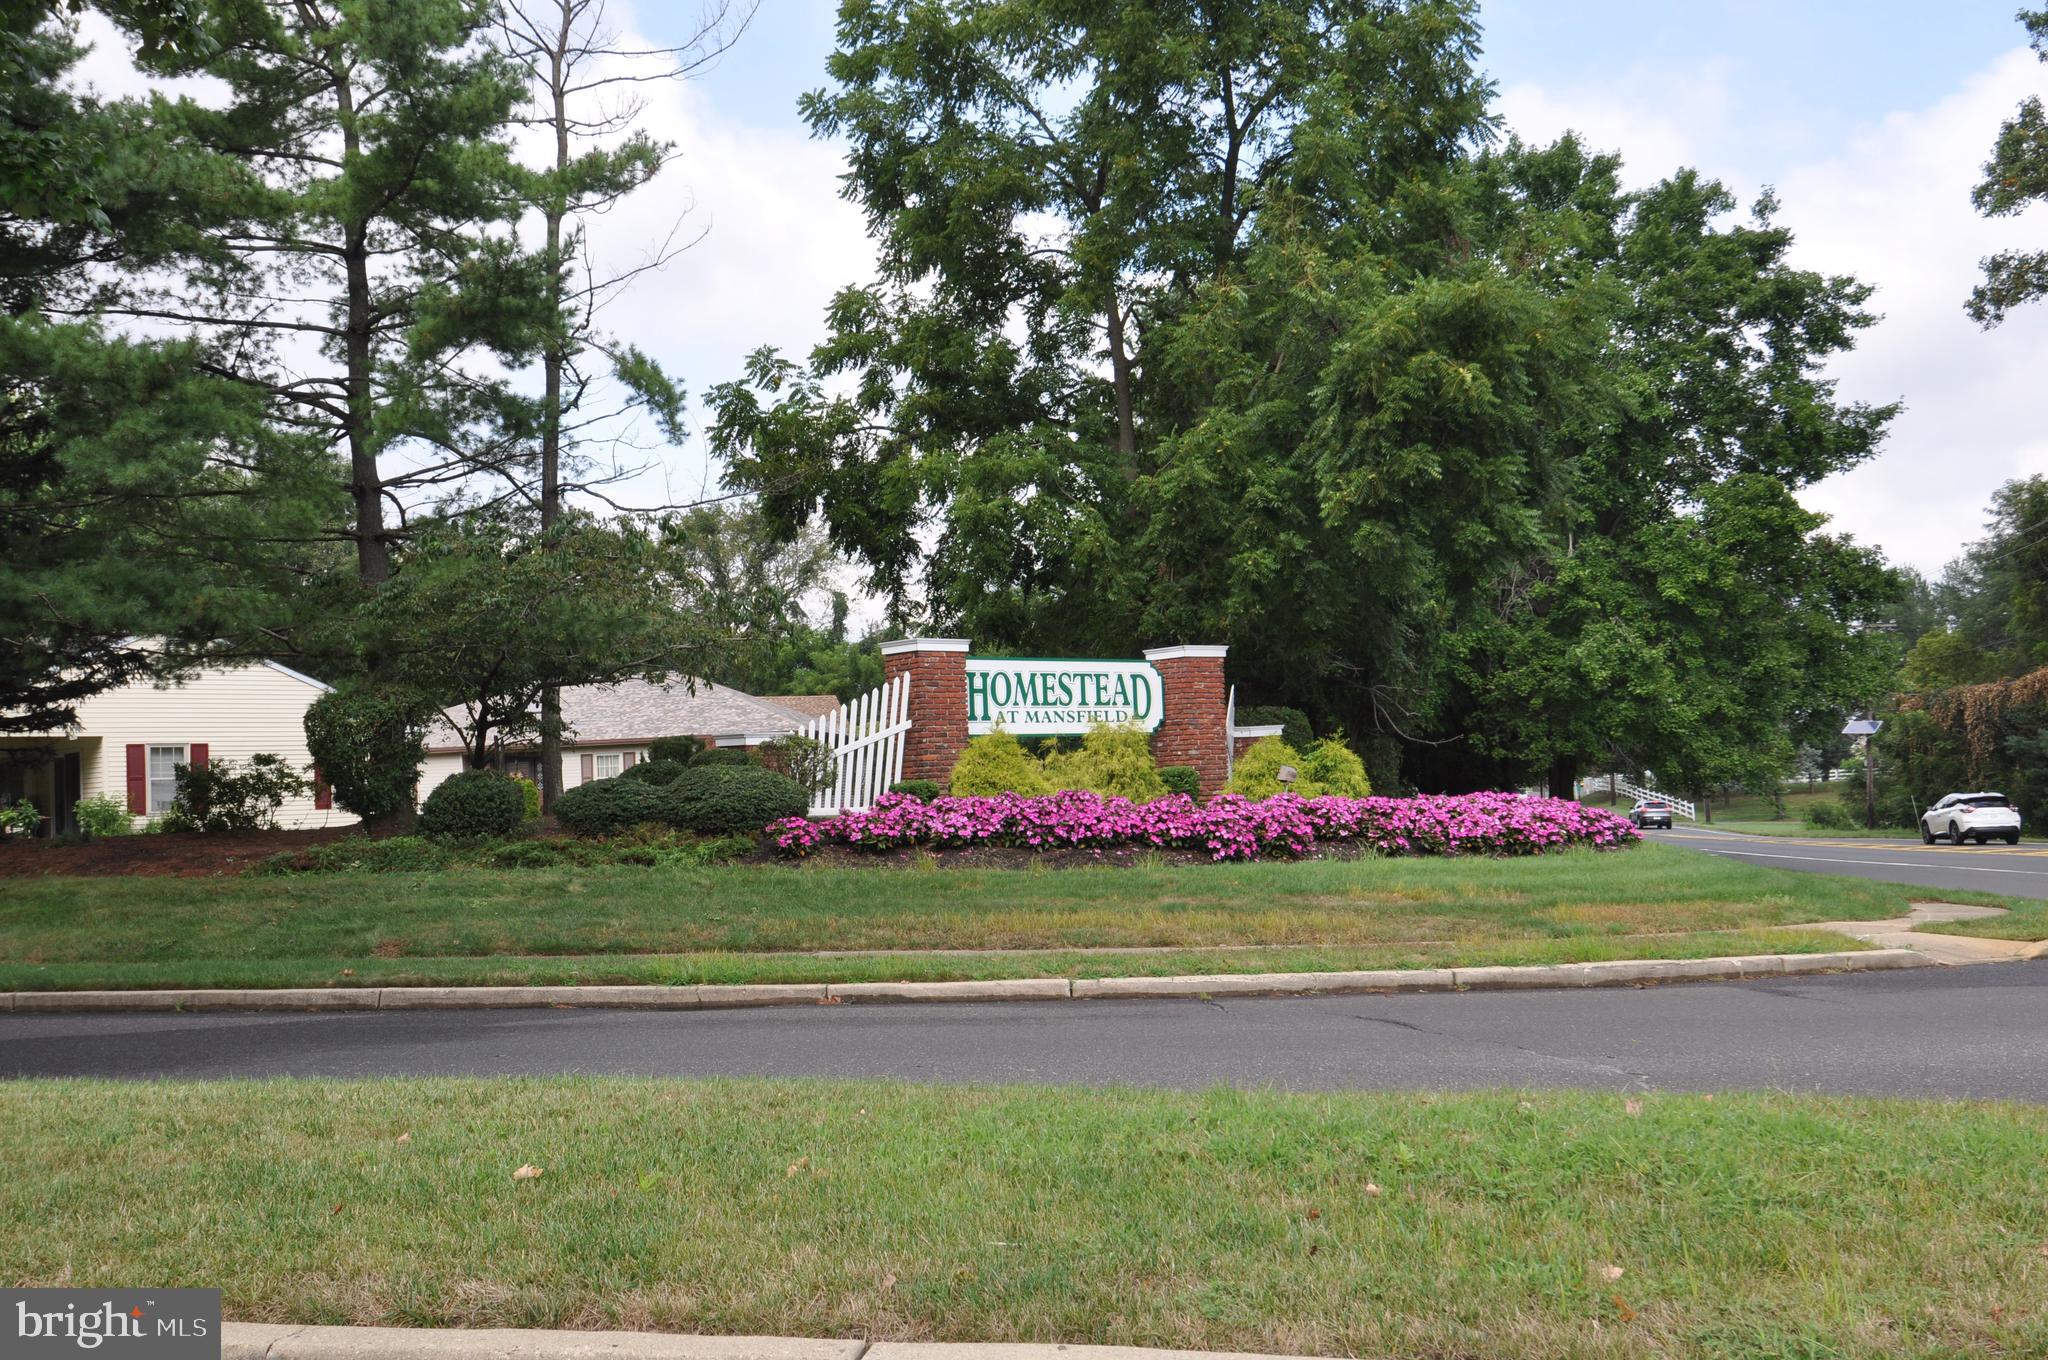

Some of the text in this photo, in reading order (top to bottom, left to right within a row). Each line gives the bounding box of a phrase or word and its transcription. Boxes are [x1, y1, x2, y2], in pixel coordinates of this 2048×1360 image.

[967, 671, 1152, 721] HOMESTEAD
[996, 710, 1128, 723] AT MANSFIELD
